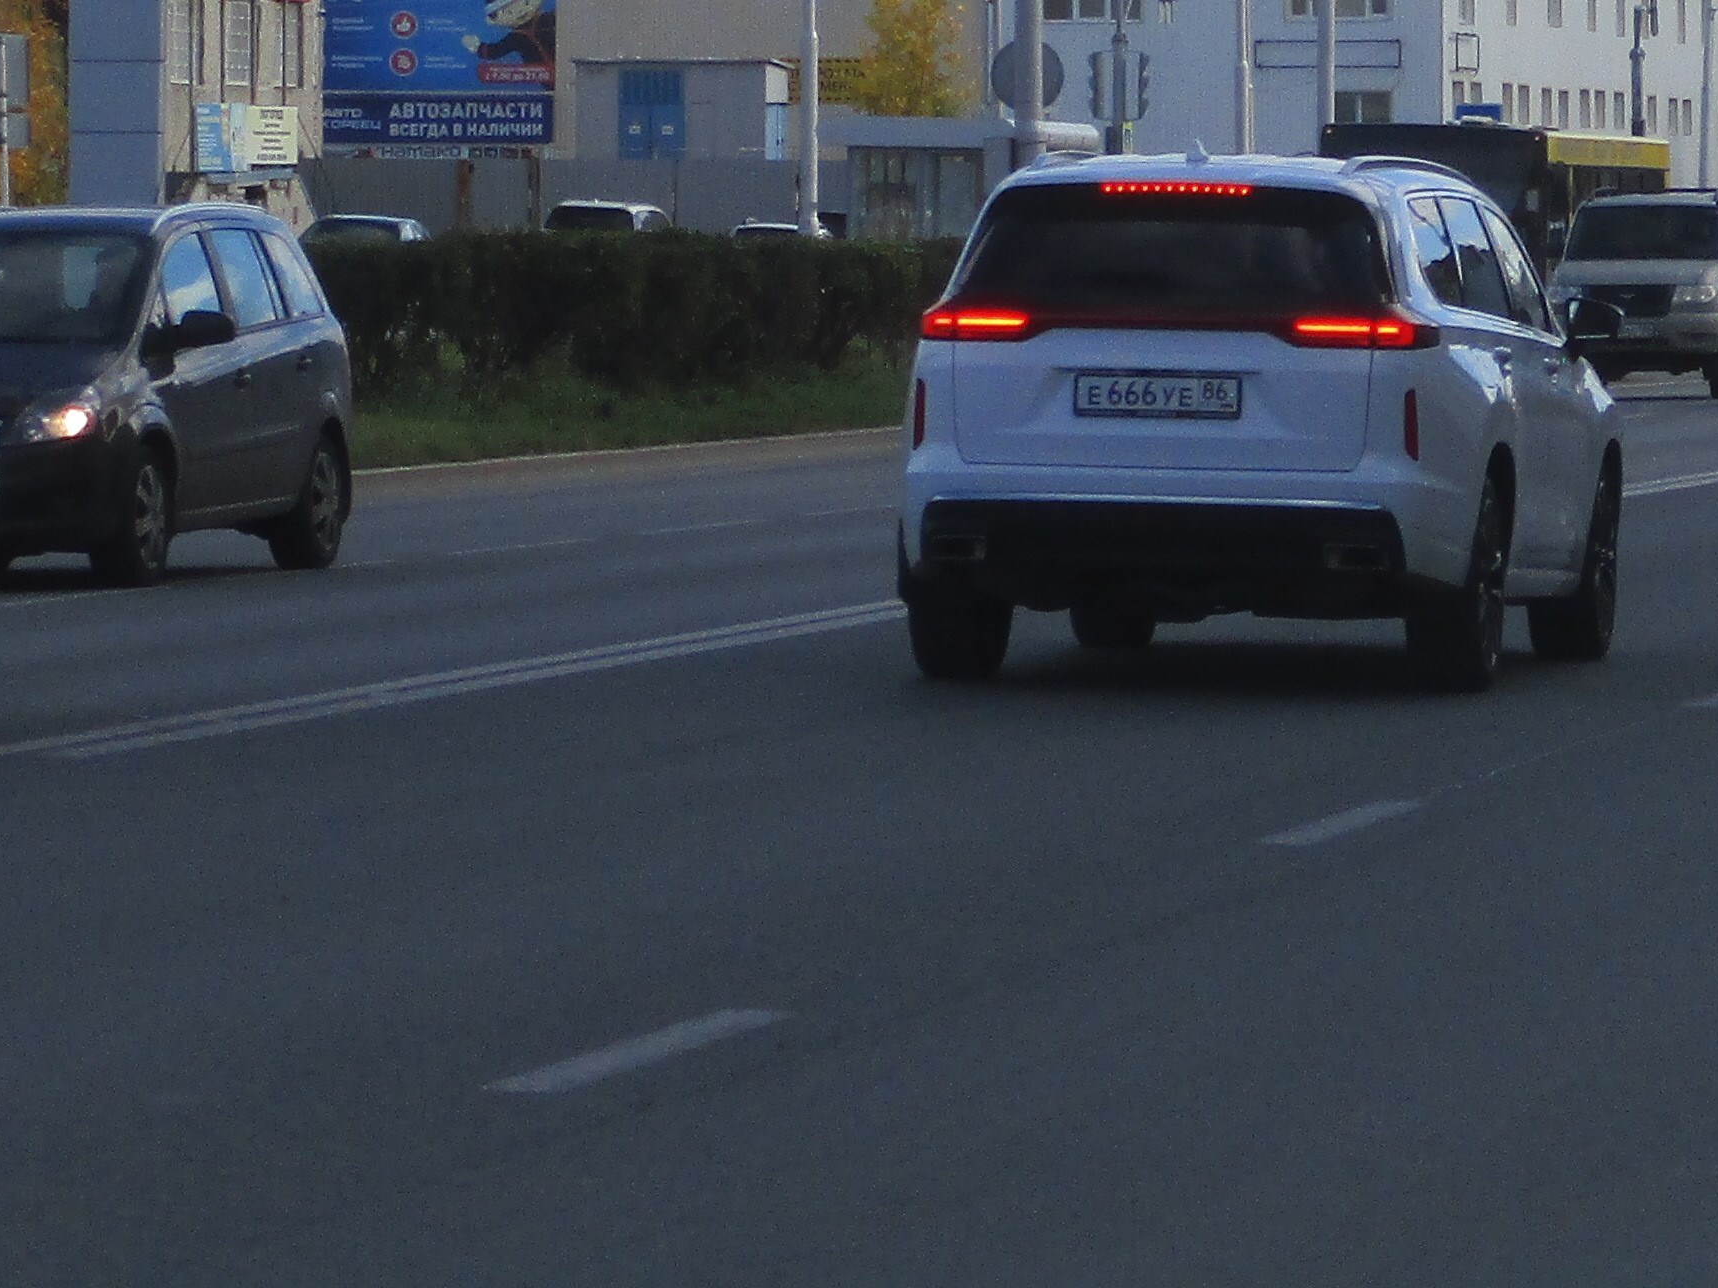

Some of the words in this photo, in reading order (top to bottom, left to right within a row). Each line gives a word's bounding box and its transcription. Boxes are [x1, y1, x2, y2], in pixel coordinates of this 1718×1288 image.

[388, 102, 543, 119] АВТОЗАПЧАСТИ
[388, 123, 448, 139] ВСЕГДА
[452, 123, 464, 137] В
[467, 123, 543, 137] НАЛИЧИИ
